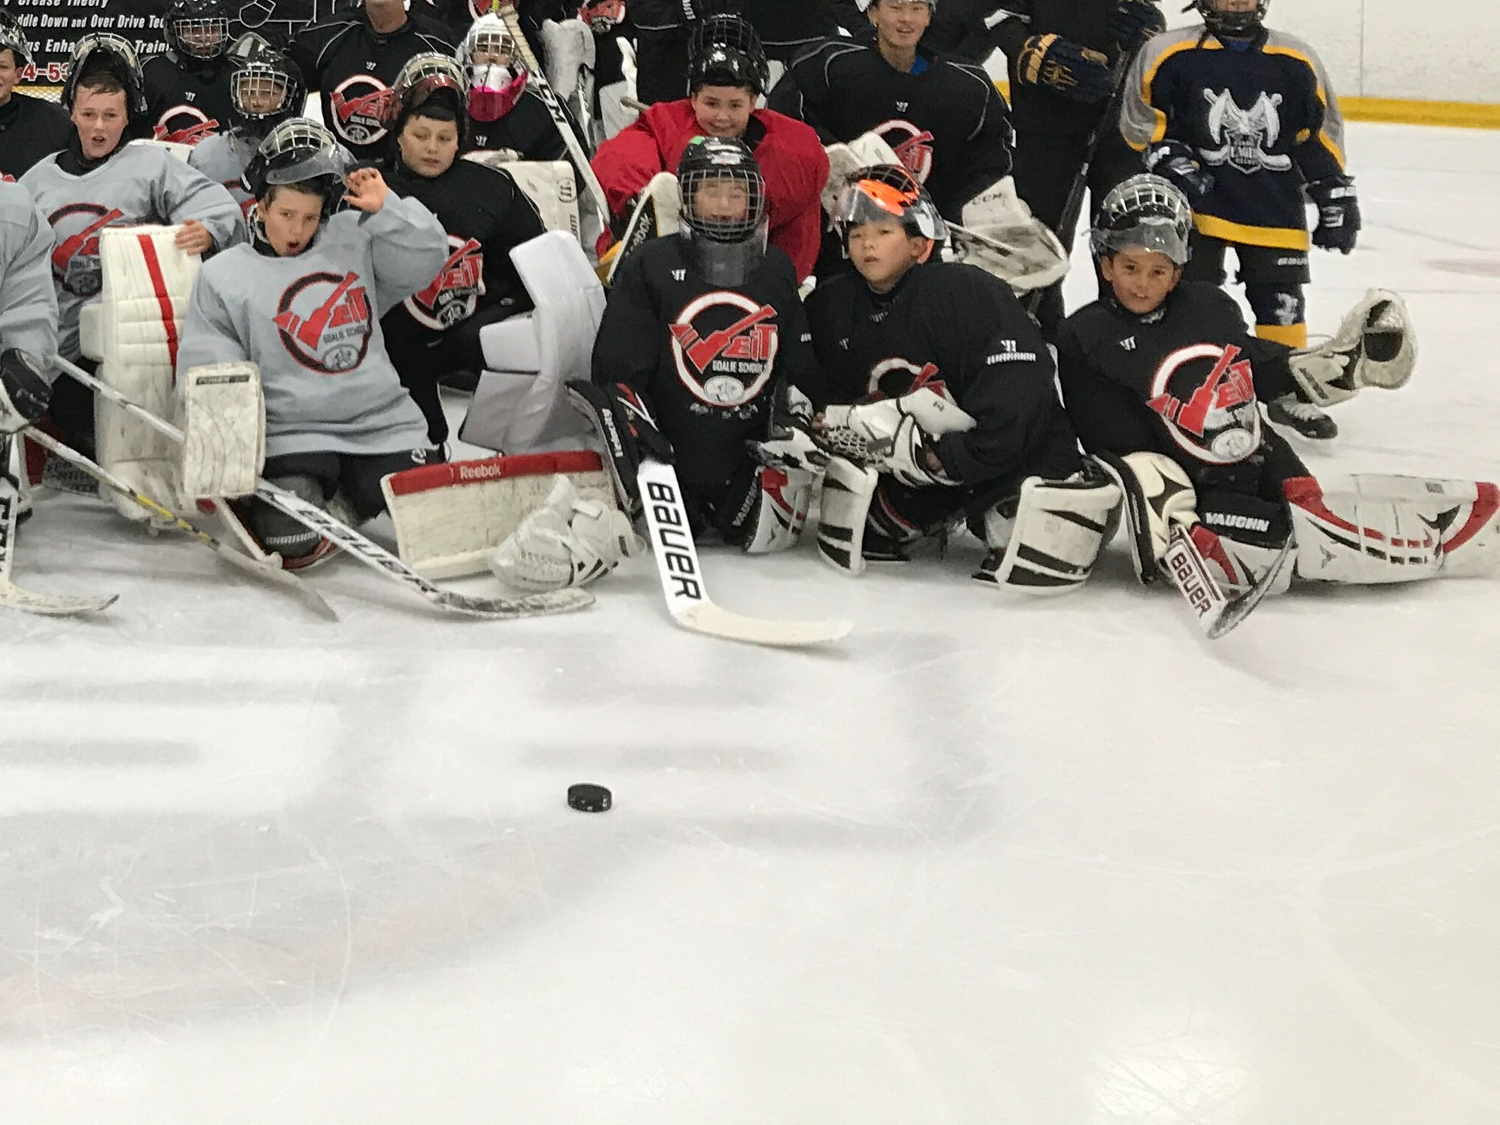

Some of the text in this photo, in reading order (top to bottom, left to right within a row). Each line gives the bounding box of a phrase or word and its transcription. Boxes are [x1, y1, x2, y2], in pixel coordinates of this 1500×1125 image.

[40, 14, 69, 29] Down
[71, 16, 87, 28] and
[90, 13, 115, 29] Over
[117, 14, 146, 29] Drive
[460, 462, 502, 481] Reebok
[1205, 511, 1270, 533] VAUGHN
